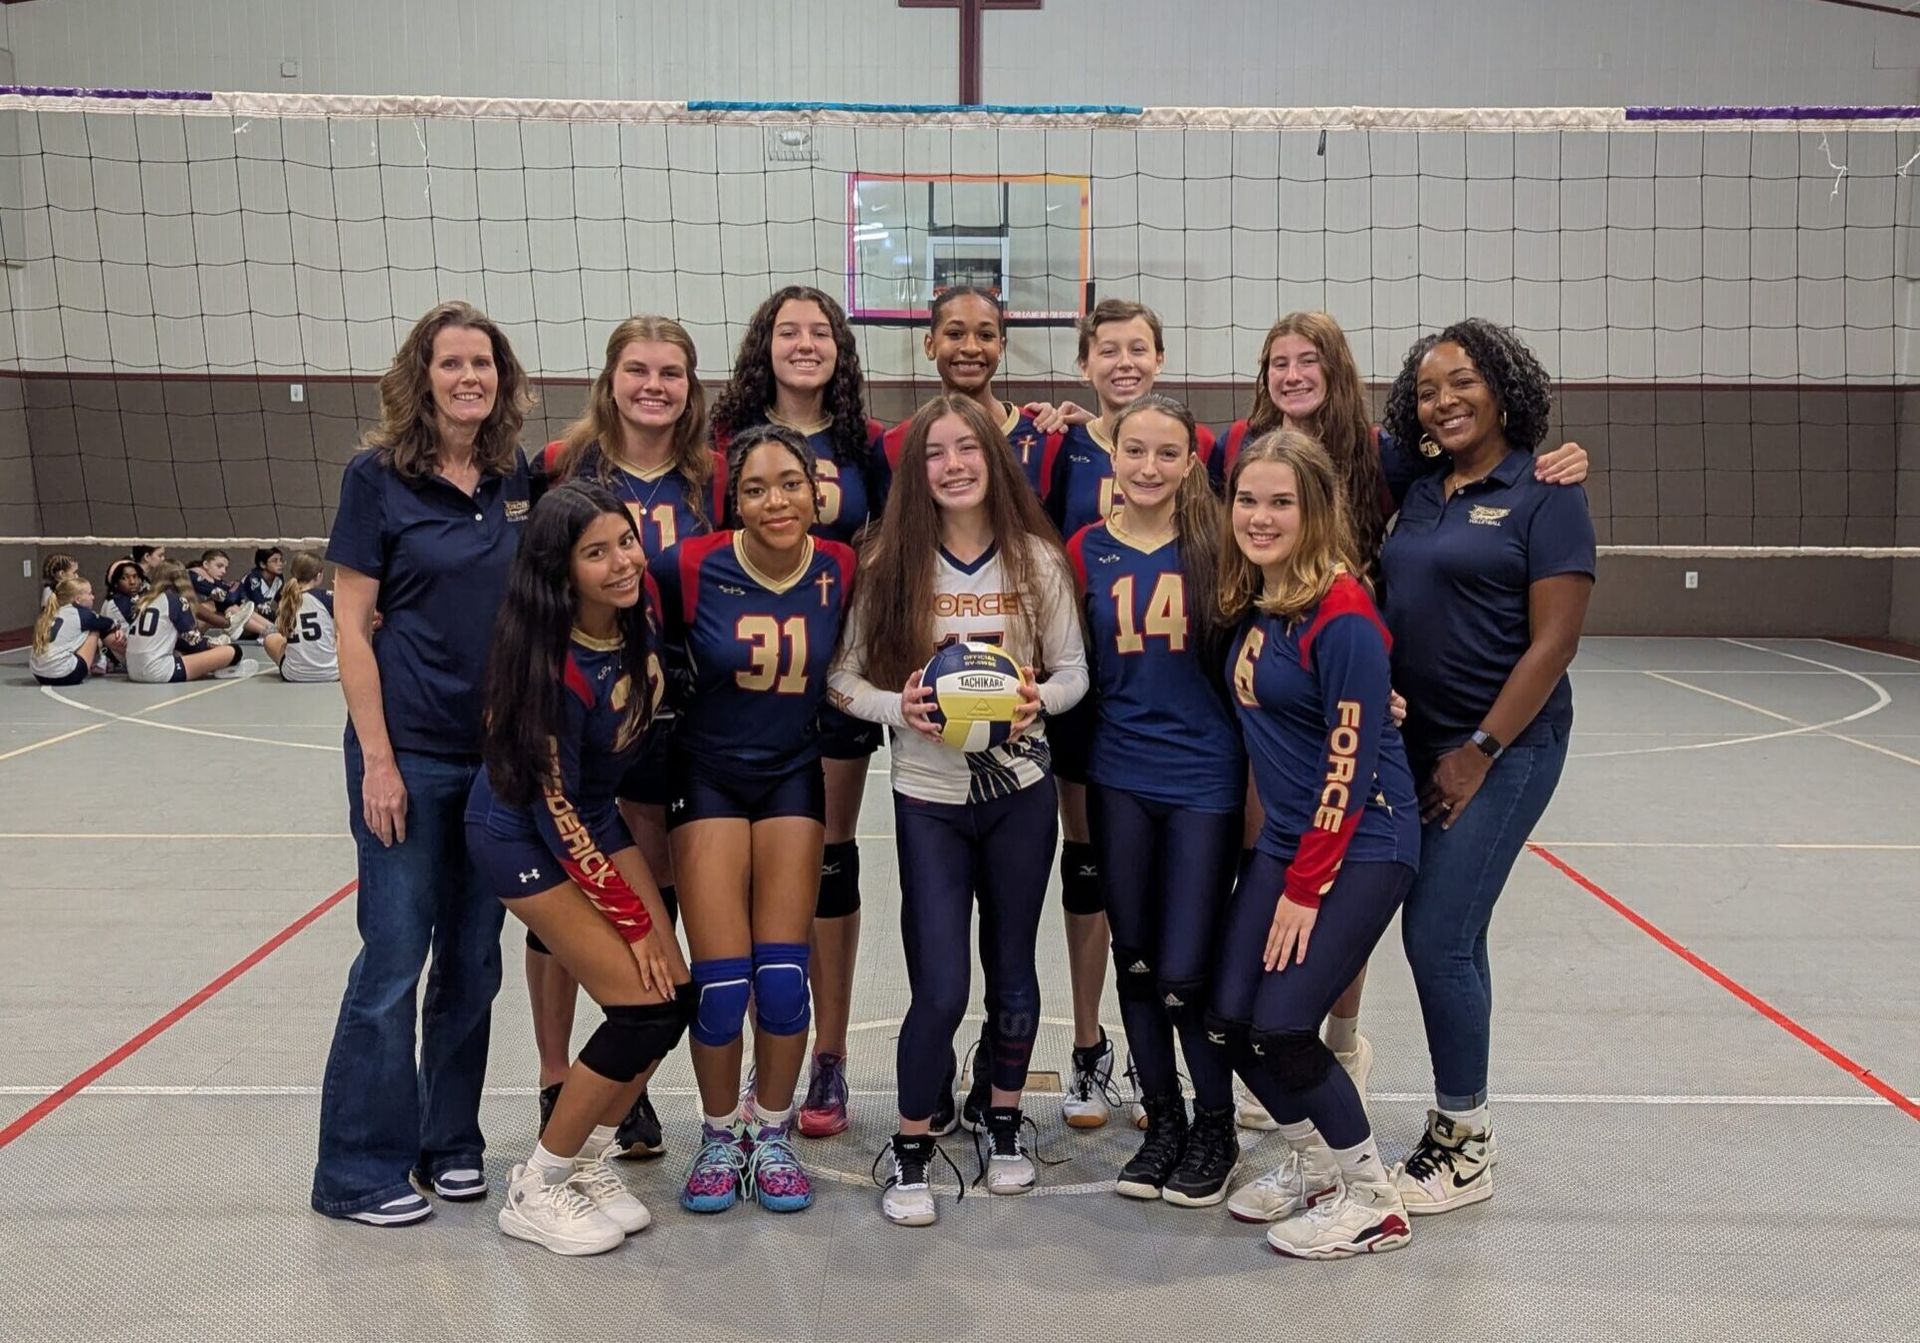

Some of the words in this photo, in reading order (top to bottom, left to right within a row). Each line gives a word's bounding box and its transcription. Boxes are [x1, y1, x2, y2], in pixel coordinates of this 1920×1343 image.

[128, 607, 160, 637] 0
[932, 592, 1019, 617] ORCE
[1110, 572, 1189, 654] 14
[735, 614, 809, 694] 31
[959, 676, 1004, 688] TACHIKARA
[1313, 700, 1361, 834] FORCE
[543, 734, 618, 889] DERICK
